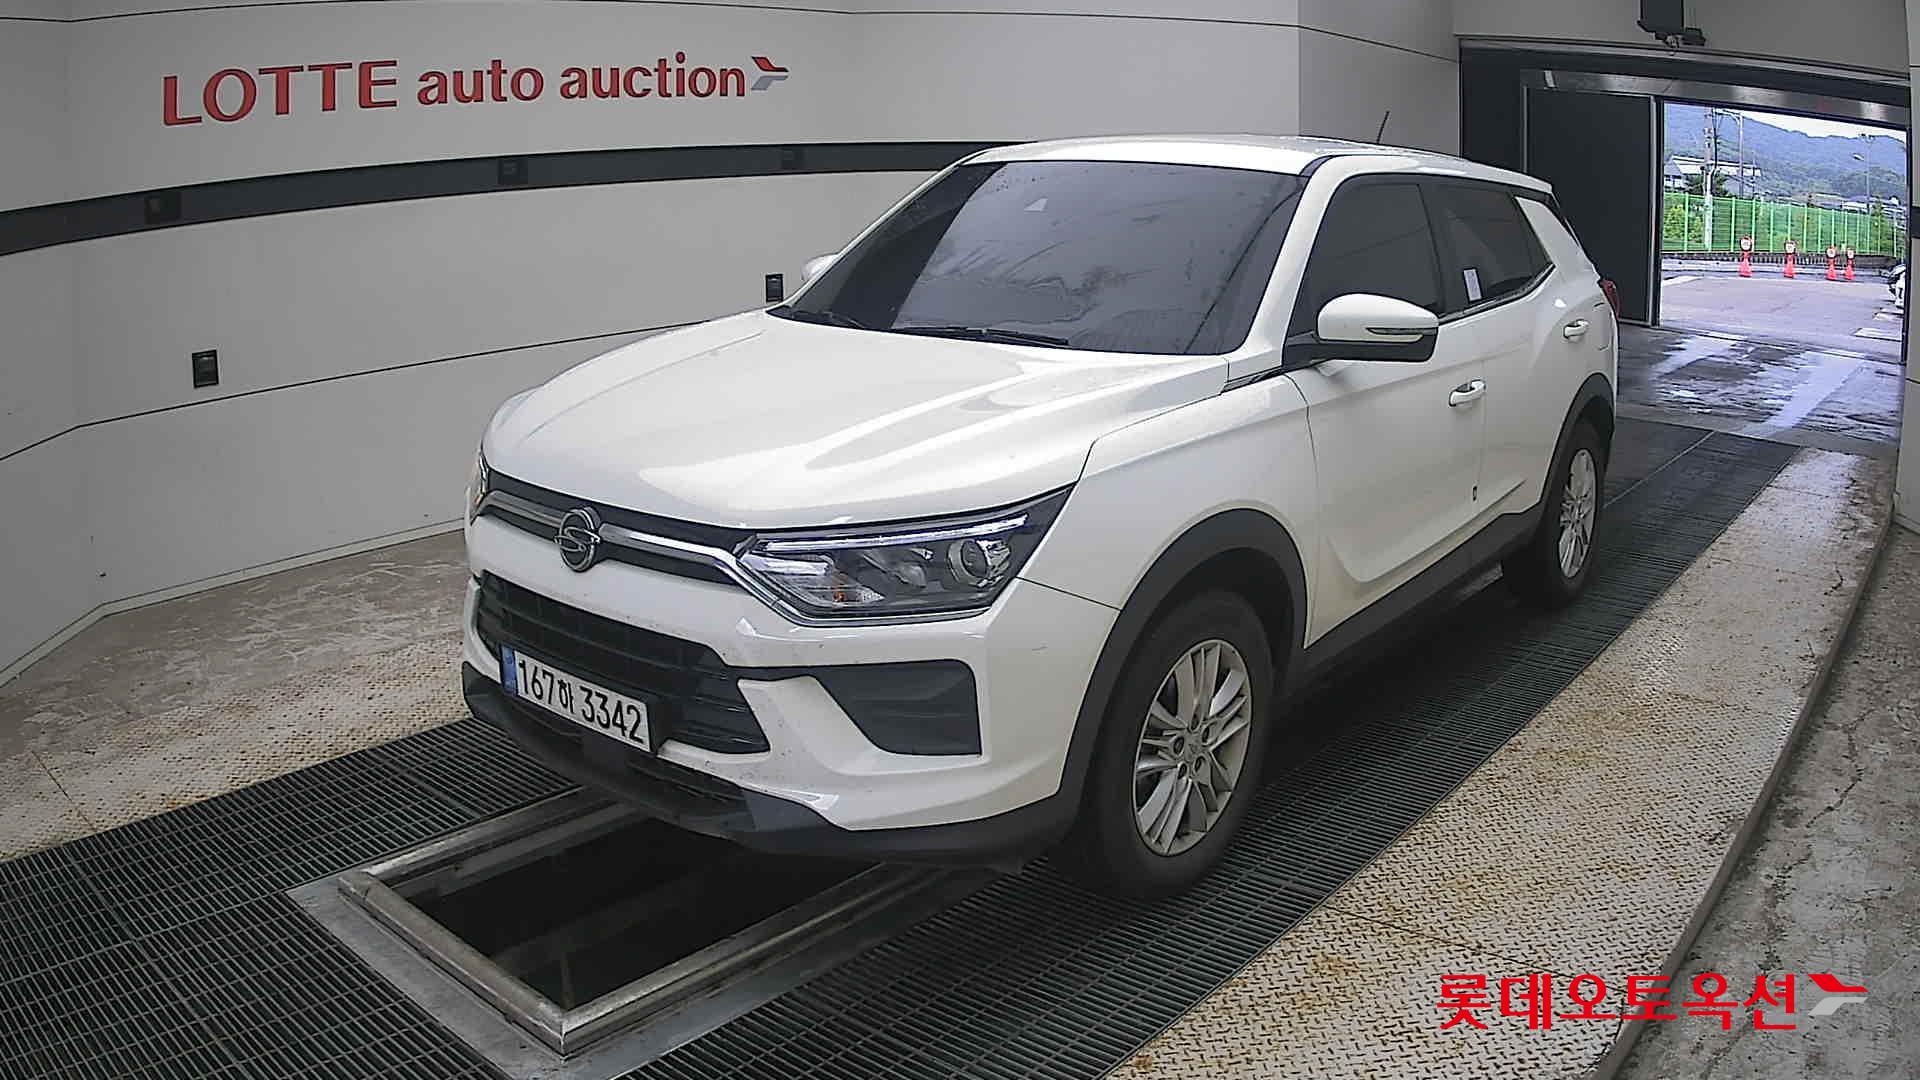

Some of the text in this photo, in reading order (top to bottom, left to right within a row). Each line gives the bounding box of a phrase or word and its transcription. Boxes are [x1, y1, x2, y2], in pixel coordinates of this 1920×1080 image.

[163, 51, 746, 127] LOTTE auto auction
[518, 659, 644, 744] 167하 3342
